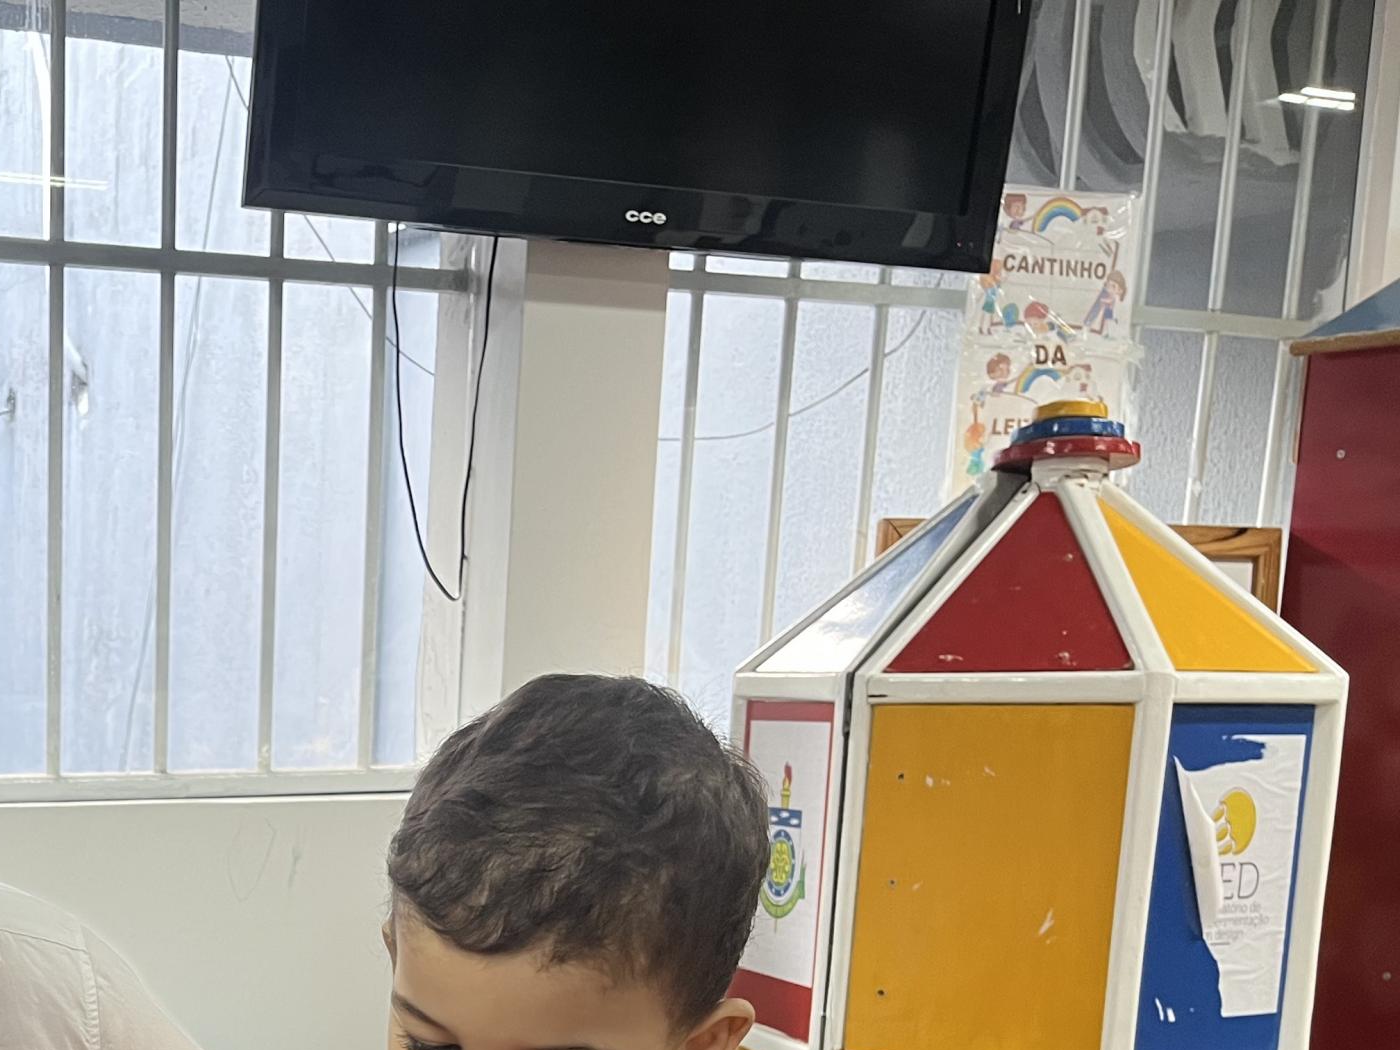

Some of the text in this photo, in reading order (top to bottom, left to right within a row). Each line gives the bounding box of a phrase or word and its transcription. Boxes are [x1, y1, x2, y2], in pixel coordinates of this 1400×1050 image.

[625, 210, 667, 225] cce
[1002, 253, 1107, 280] CANTINHO
[1035, 344, 1068, 366] DA
